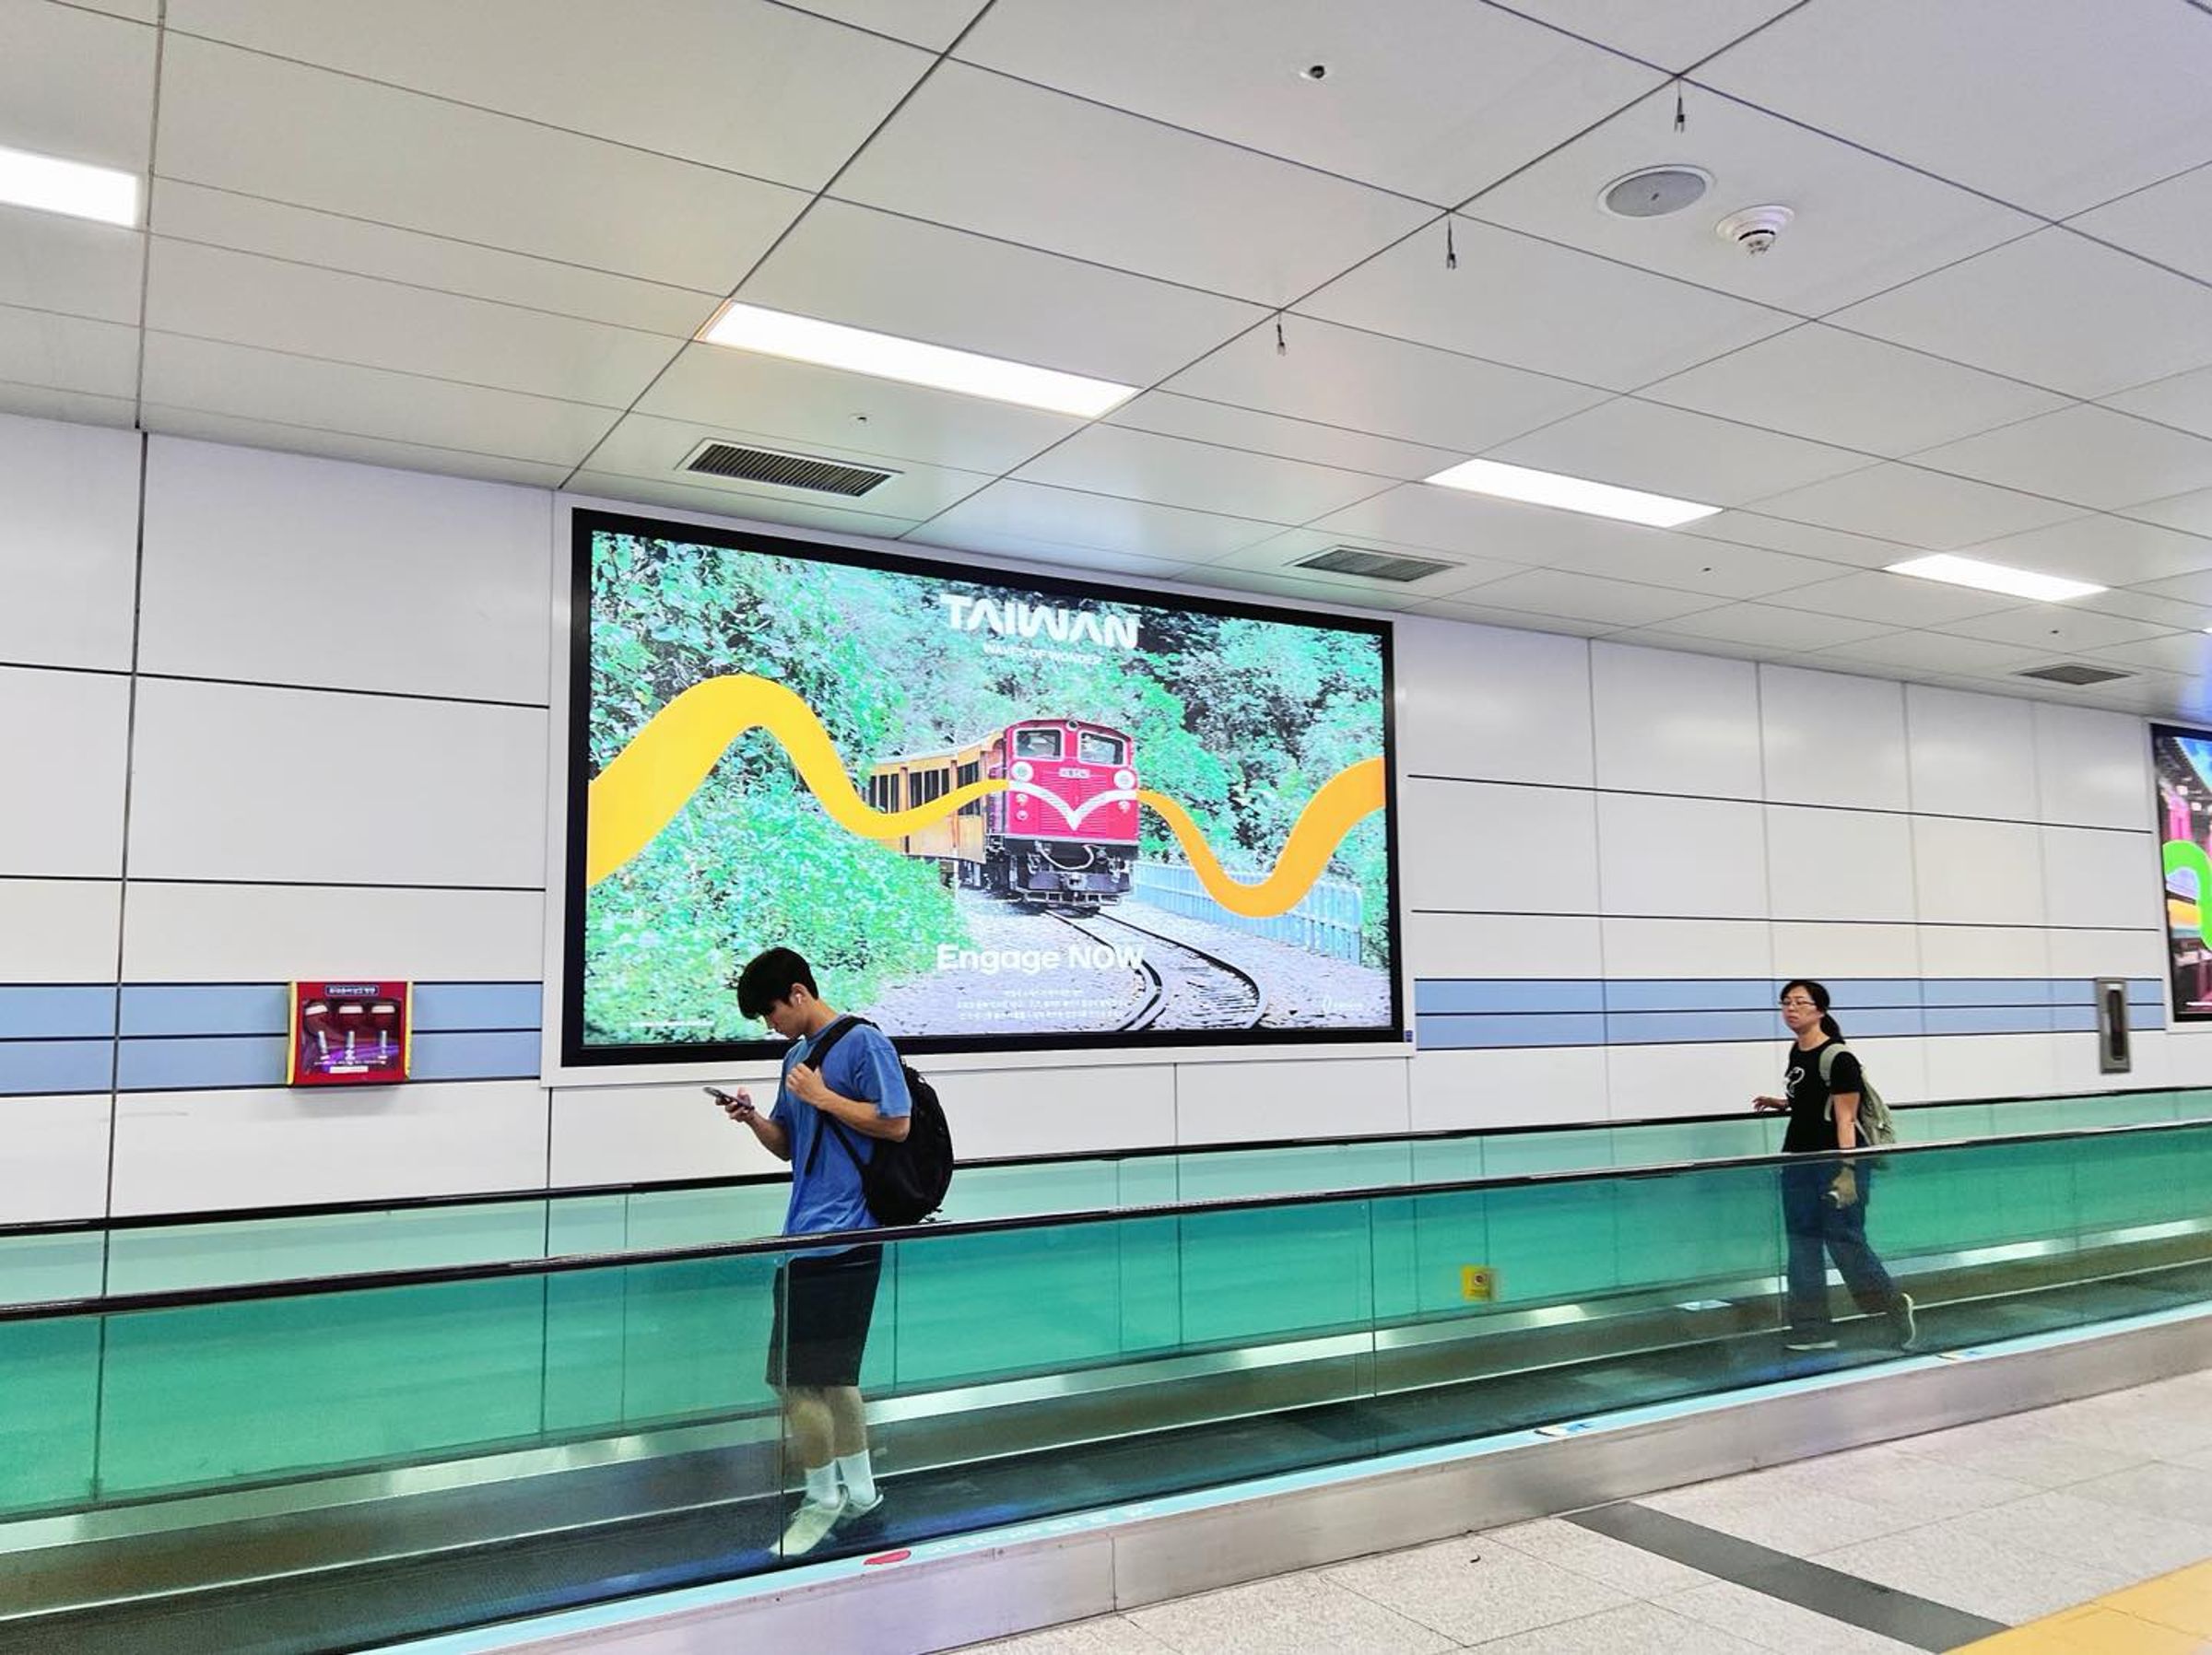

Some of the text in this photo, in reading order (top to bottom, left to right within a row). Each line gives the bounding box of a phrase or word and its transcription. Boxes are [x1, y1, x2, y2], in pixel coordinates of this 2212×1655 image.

[940, 593, 1140, 649] TAIWAN
[936, 943, 1144, 975] Engage NOW
